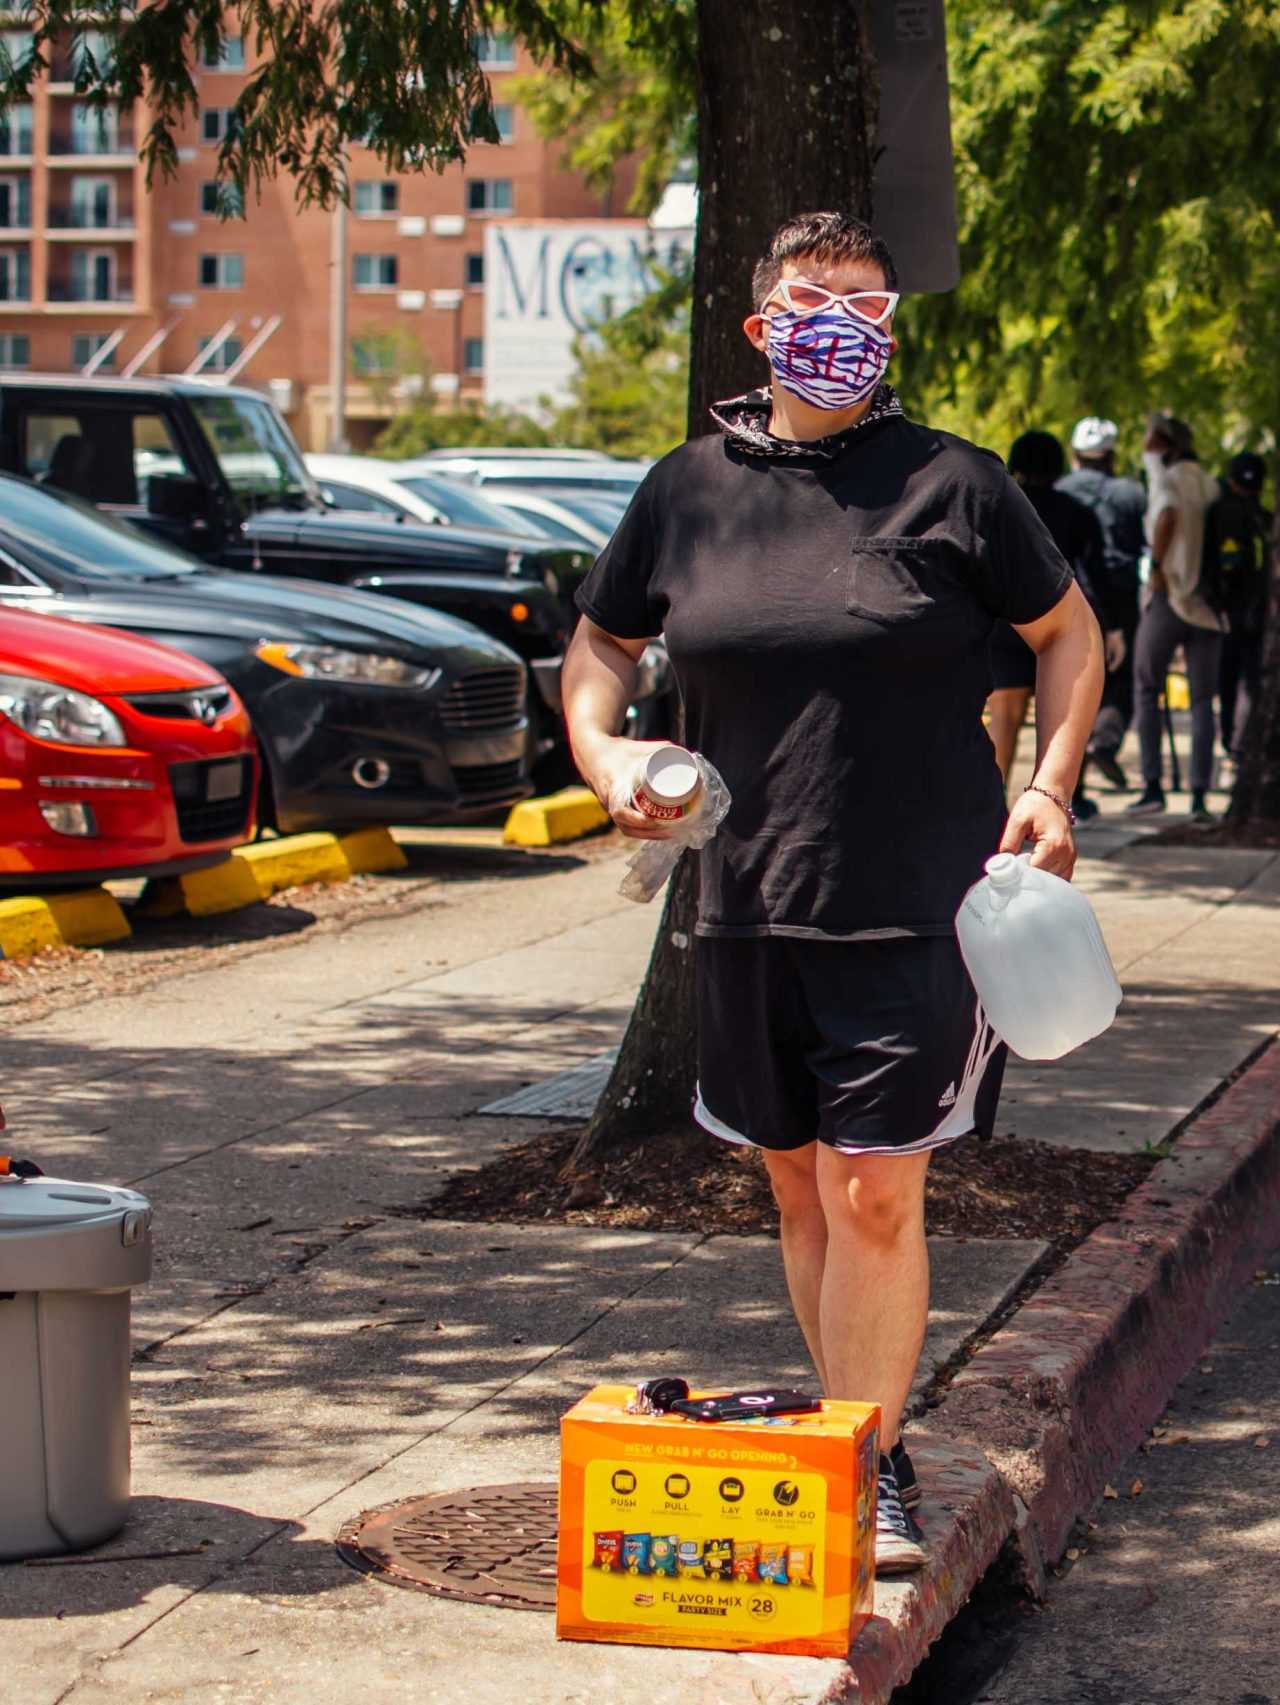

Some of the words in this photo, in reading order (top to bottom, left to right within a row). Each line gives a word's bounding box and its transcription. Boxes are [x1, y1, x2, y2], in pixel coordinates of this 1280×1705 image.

[624, 1443, 653, 1454] NEW
[656, 1445, 690, 1457] GRAB
[707, 1448, 728, 1459] GO
[730, 1450, 788, 1464] OPENING
[610, 1498, 637, 1508] PUSH
[664, 1502, 689, 1511] PULL
[721, 1506, 741, 1515] LAY
[755, 1508, 784, 1518] GRAB
[799, 1511, 816, 1519] GO
[663, 1592, 715, 1606] FLAVOR
[718, 1597, 743, 1608] MIX
[681, 1606, 705, 1614] PARTY
[707, 1608, 724, 1616] SIZE
[751, 1599, 774, 1614] 28
